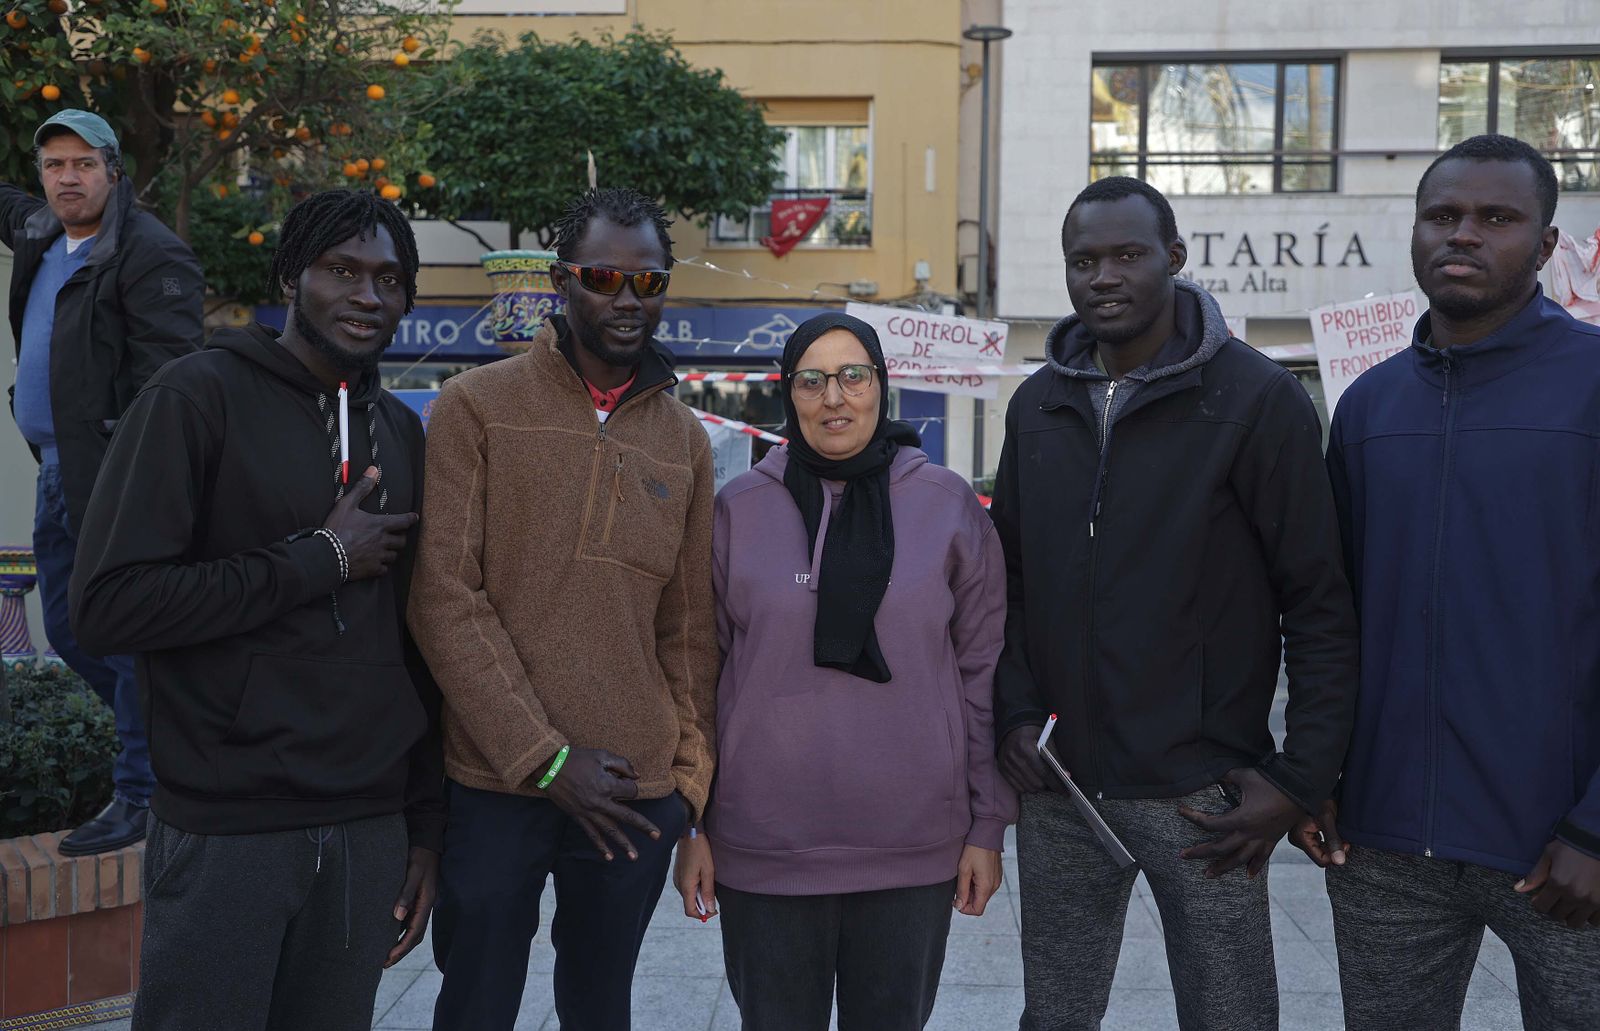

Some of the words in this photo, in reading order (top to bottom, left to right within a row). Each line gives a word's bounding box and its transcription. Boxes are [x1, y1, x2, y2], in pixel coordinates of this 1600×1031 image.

[1191, 222, 1372, 267] TARÍA
[1241, 270, 1288, 293] Alta
[1321, 299, 1416, 333] PROHIBIDO
[912, 341, 934, 359] DE
[1346, 322, 1407, 350] PASAR
